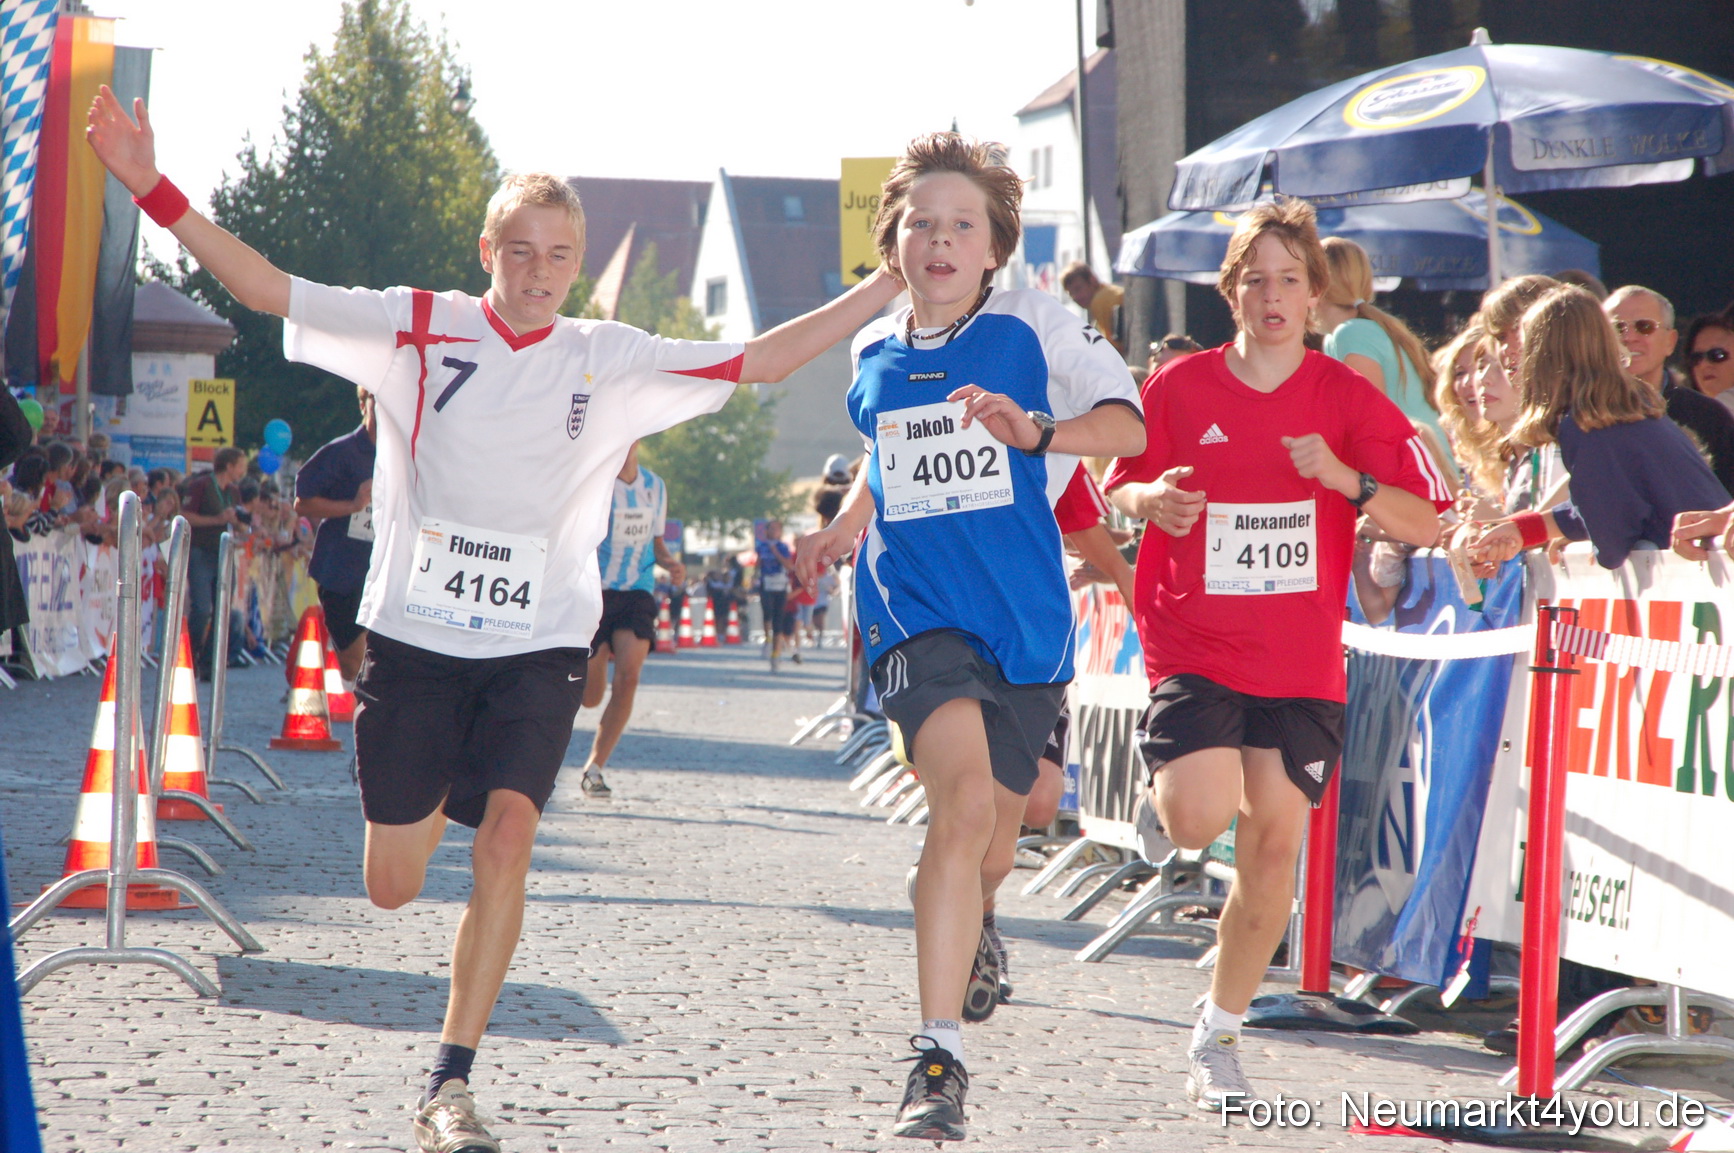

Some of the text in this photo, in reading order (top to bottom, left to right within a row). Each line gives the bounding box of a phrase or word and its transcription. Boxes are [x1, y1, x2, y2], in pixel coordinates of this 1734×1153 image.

[1531, 137, 1616, 160] DUNKLE
[433, 356, 478, 413] 7
[909, 372, 946, 381] STANNO
[193, 381, 230, 395] Block
[197, 399, 223, 432] A
[906, 416, 955, 440] Jakob
[1199, 435, 1229, 445] adidas
[886, 453, 896, 471] J
[912, 446, 1000, 486] 4002
[961, 489, 1011, 504] PFLEIDERER
[887, 500, 931, 516] BOCK
[1235, 512, 1311, 531] Alexander
[449, 535, 512, 562] Florian
[1212, 538, 1222, 552] J
[1237, 541, 1309, 569] 4109
[419, 558, 432, 573] J
[444, 570, 531, 610] 4164
[1276, 577, 1315, 588] PFLEIDERER
[407, 604, 456, 620] BOCK
[484, 618, 531, 632] PFLEIDERER
